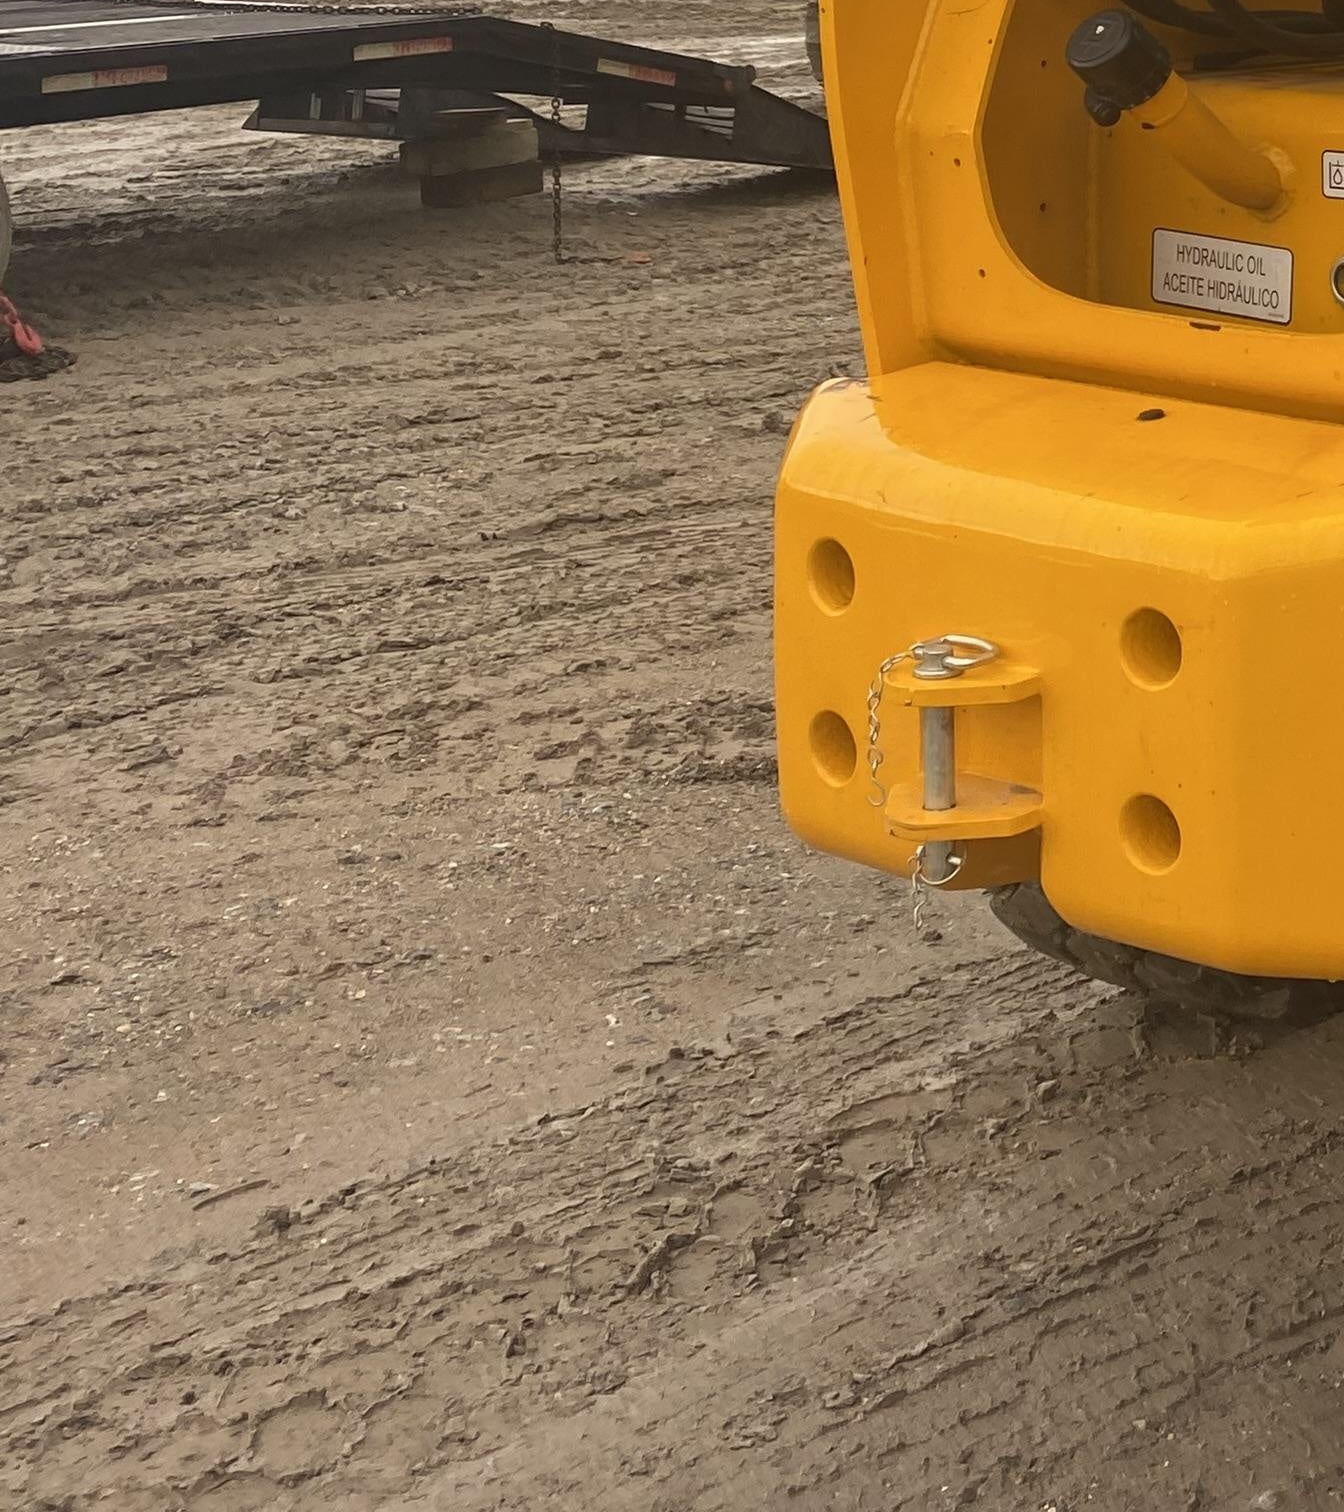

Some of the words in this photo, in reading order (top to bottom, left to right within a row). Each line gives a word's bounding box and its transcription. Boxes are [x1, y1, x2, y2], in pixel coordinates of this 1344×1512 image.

[1176, 243, 1244, 273] HYDRAULIC
[1247, 256, 1266, 276] OIL
[1162, 272, 1204, 297] ACEITE
[1207, 277, 1280, 310] HIDRÁULICO
